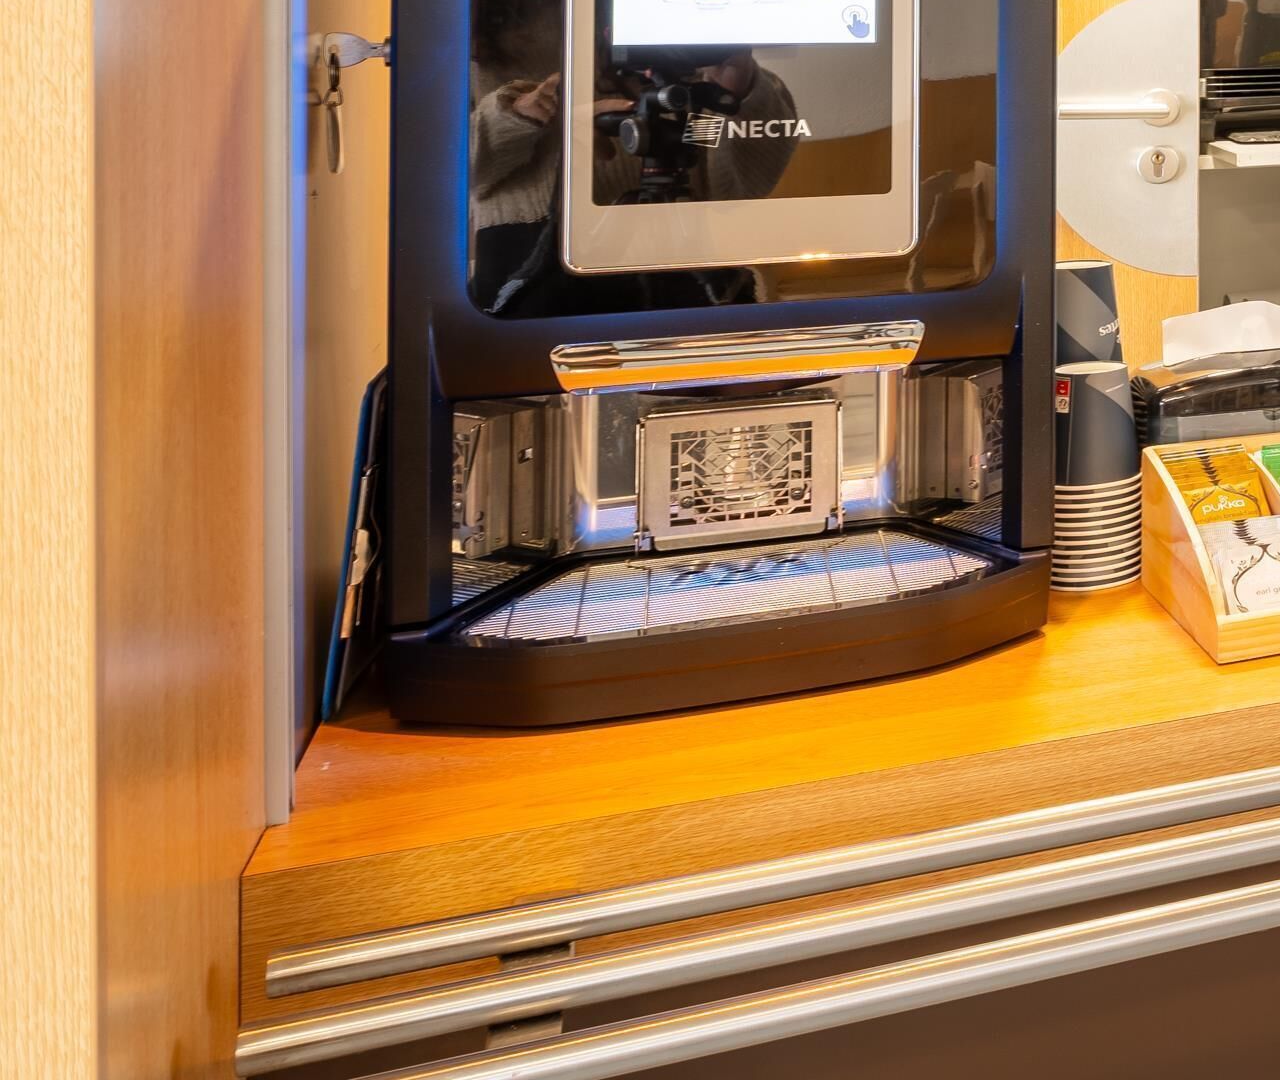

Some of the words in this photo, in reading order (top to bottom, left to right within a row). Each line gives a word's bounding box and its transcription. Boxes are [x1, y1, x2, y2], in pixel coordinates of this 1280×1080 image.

[727, 119, 812, 139] NECTA
[1201, 498, 1246, 516] pukka
[1256, 587, 1271, 596] earl
